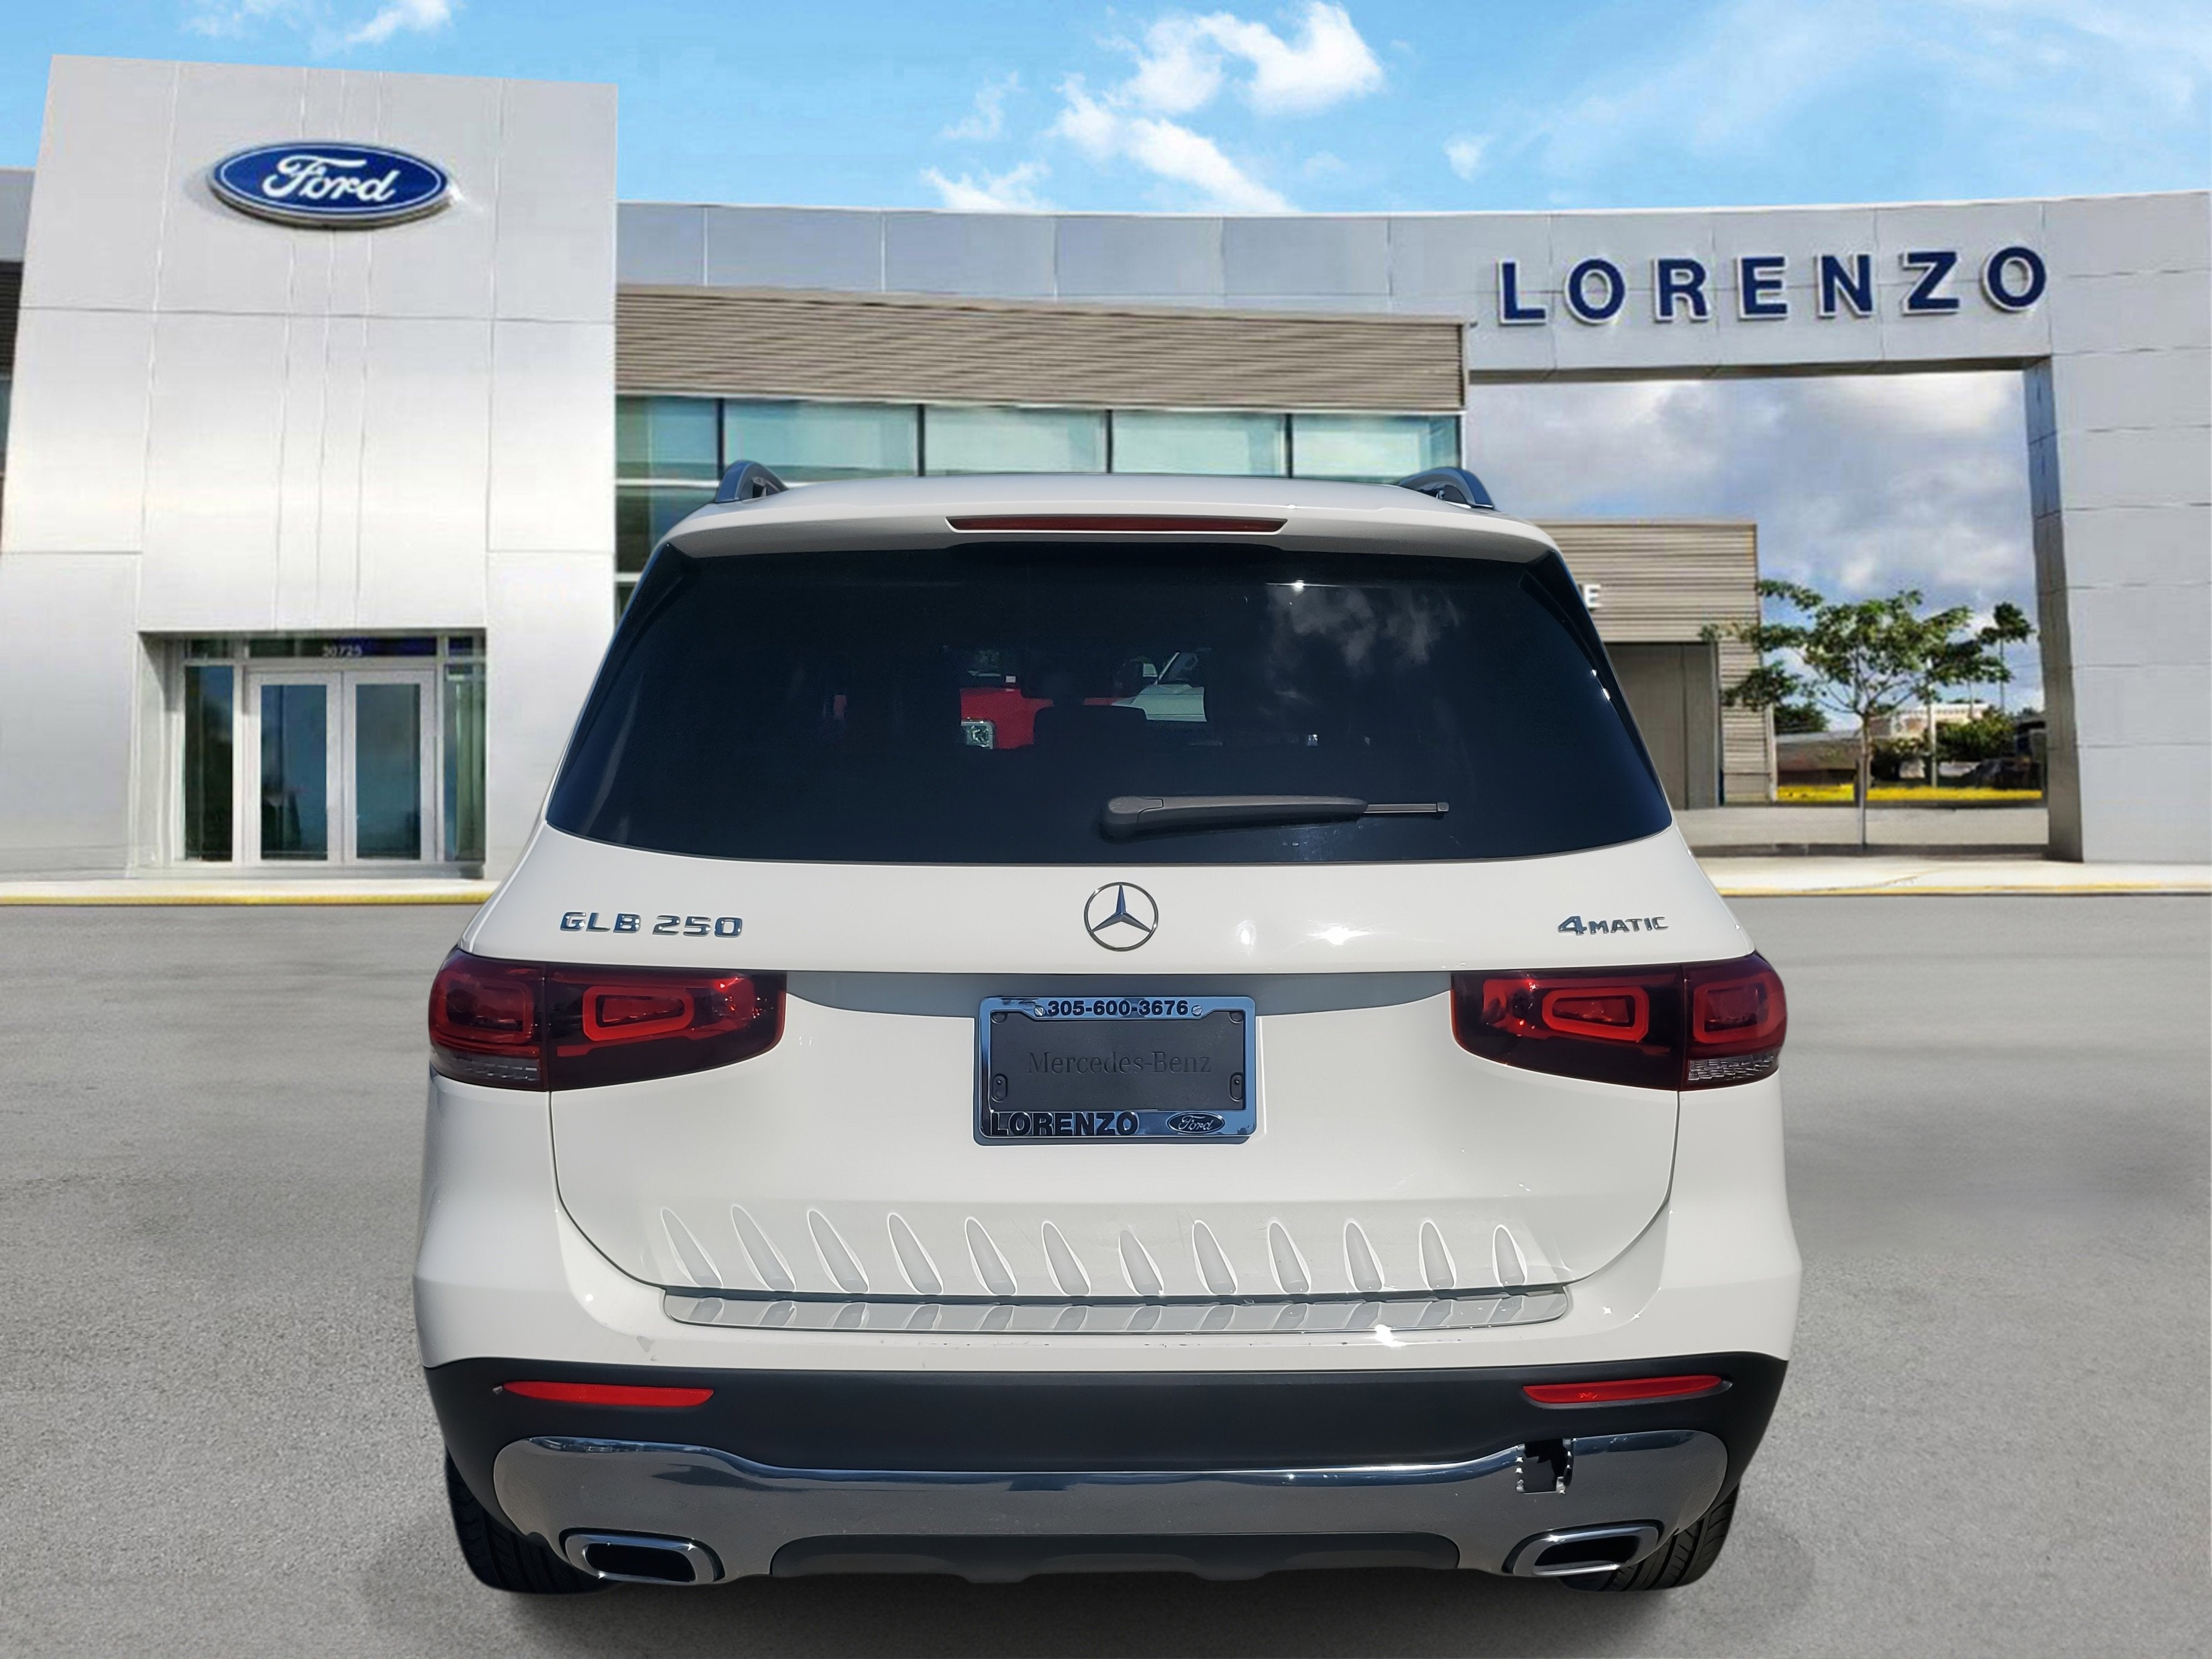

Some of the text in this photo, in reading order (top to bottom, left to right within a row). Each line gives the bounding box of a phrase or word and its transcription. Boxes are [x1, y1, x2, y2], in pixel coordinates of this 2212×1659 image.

[262, 155, 400, 202] Ford
[1498, 246, 2047, 325] LORENZO
[560, 912, 743, 938] GLB 250
[1048, 1000, 1188, 1016] 305-600-3676
[1027, 1051, 1212, 1074] Mercedes-Benz
[991, 1111, 1139, 1135] LORENZO
[1179, 1115, 1213, 1131] Ford
